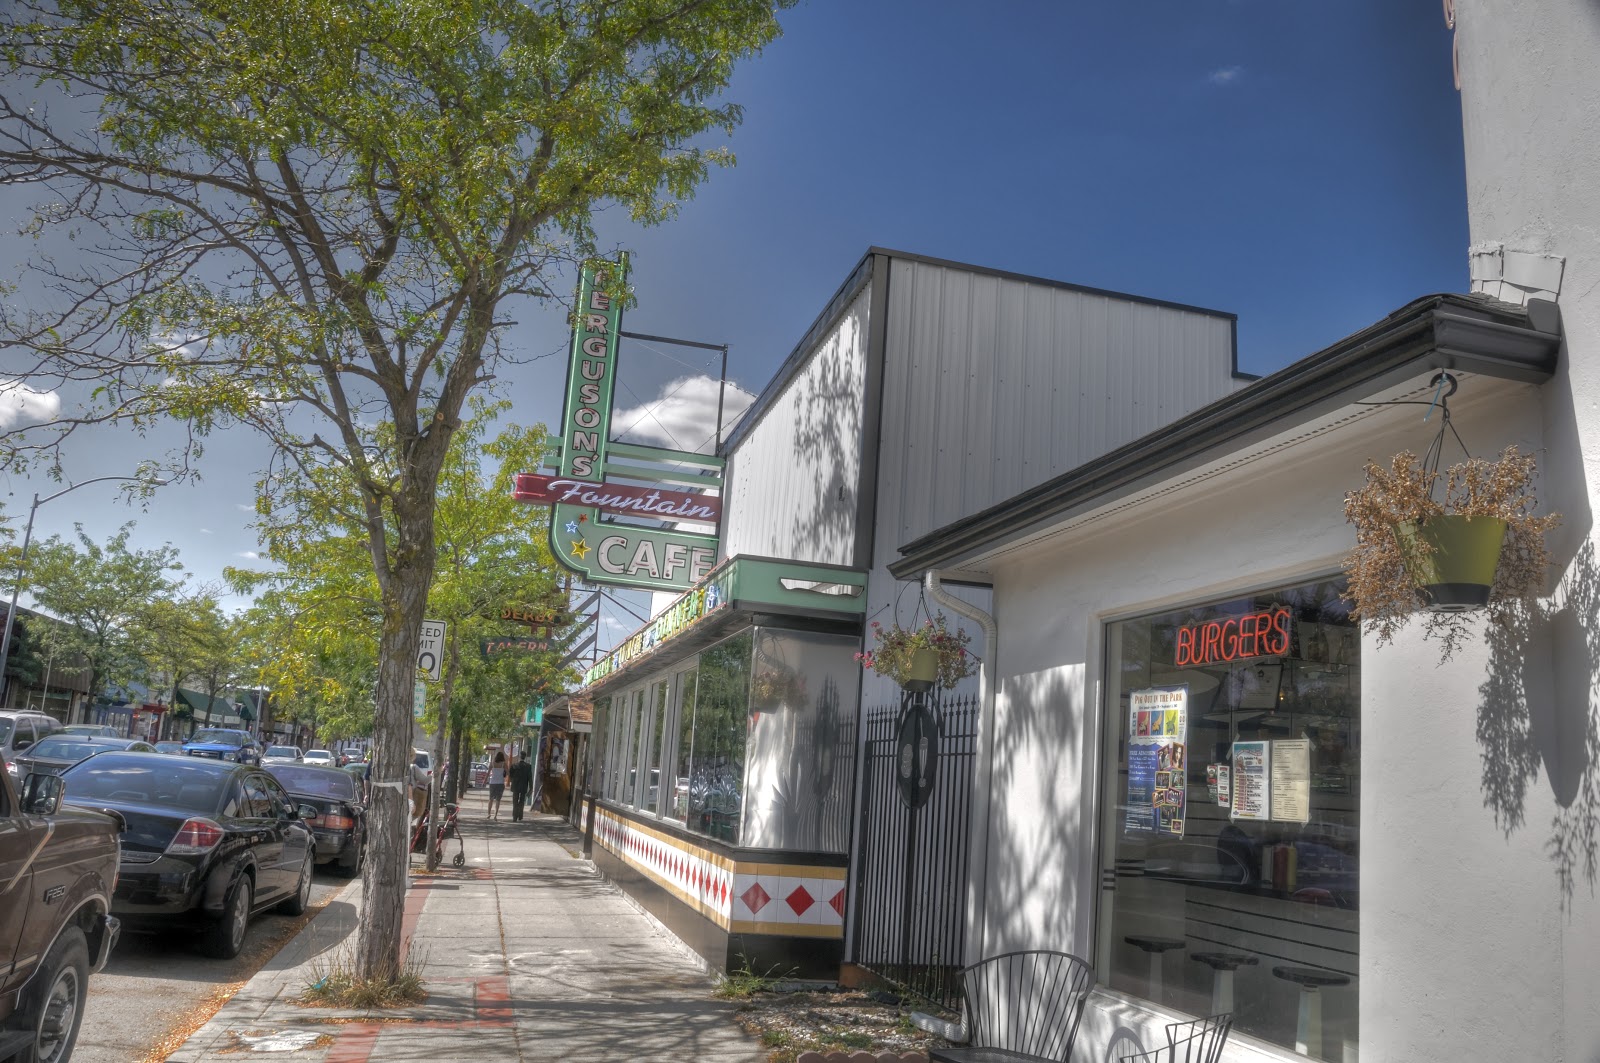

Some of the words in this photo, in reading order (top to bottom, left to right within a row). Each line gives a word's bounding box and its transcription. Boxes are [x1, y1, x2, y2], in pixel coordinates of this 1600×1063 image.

[547, 480, 715, 518] Fountain
[597, 535, 715, 583] CAFE
[419, 627, 441, 638] EED
[1177, 610, 1290, 665] BURGERS
[418, 651, 436, 675] 0
[1169, 692, 1183, 702] PARK
[46, 885, 66, 904] F250
